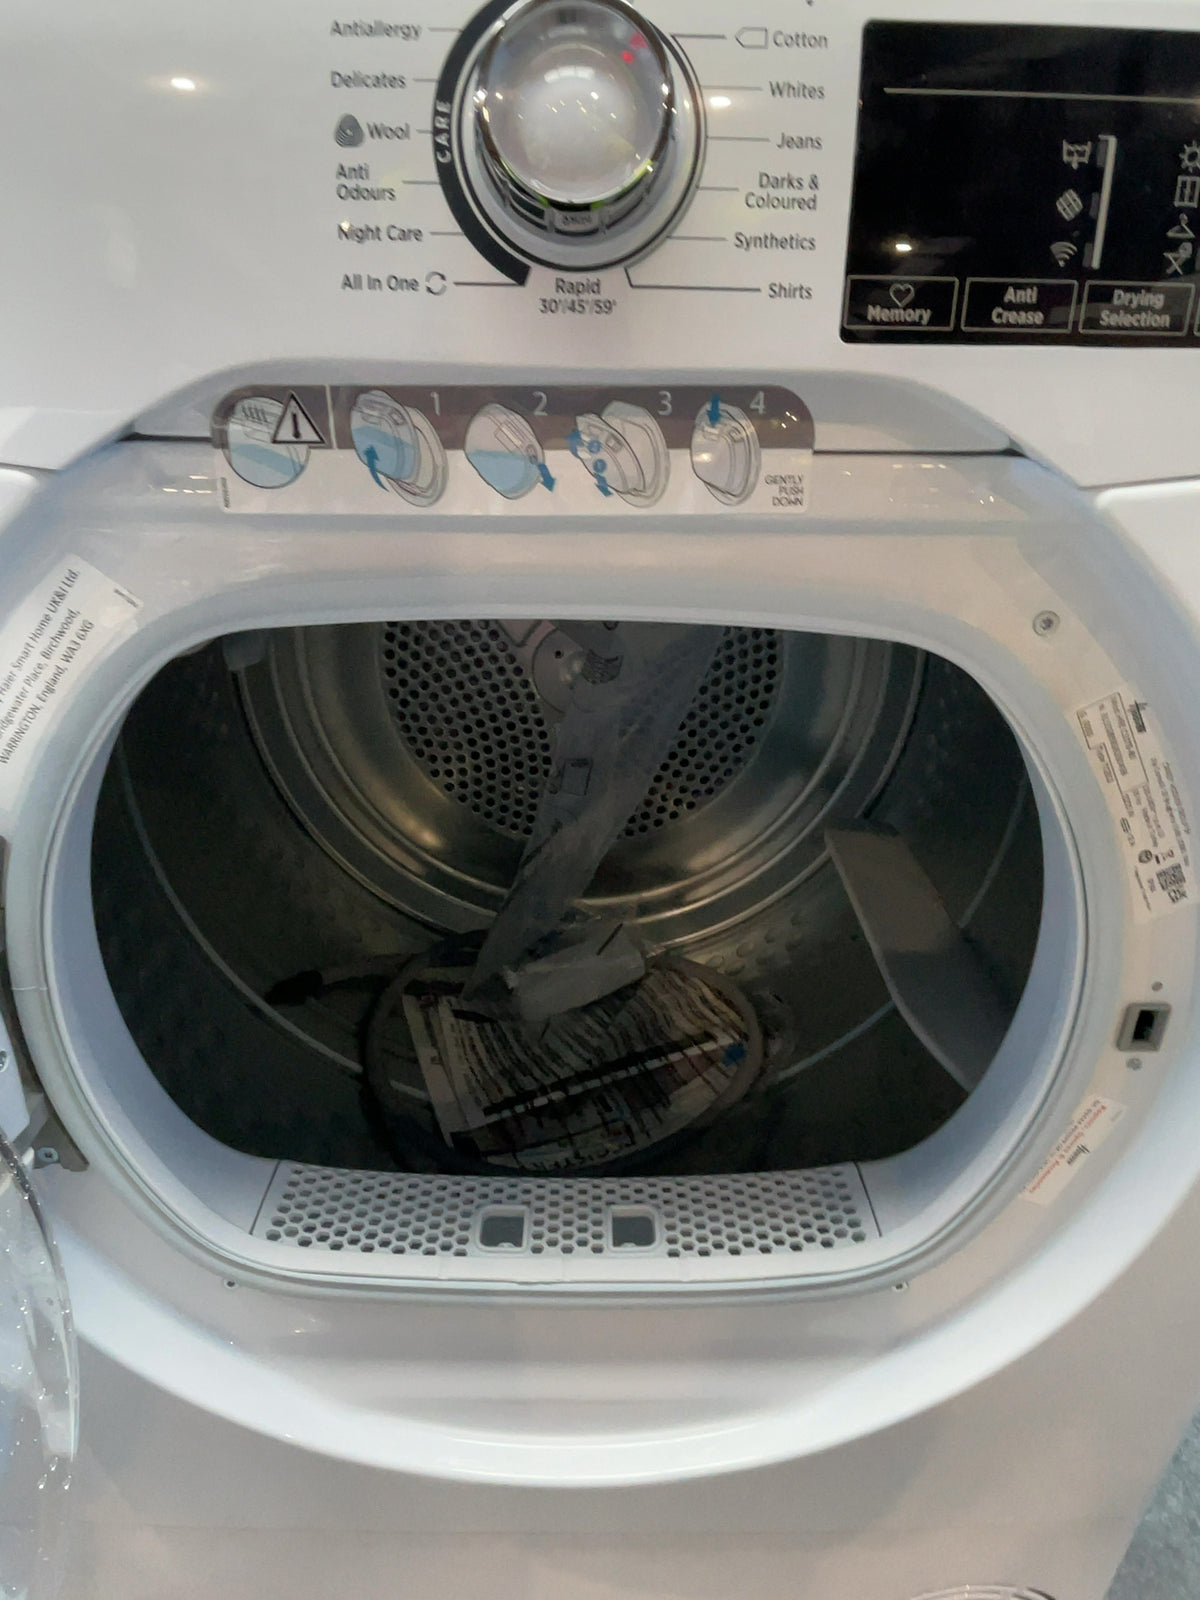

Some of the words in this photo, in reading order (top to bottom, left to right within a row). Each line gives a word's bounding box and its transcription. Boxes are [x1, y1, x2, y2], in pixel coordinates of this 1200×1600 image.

[330, 20, 421, 40] Antiallergy
[772, 30, 828, 50] Cotton
[330, 70, 406, 89] Delicates
[768, 80, 826, 101] Whites
[366, 121, 410, 141] Wool
[434, 99, 452, 164] CARE
[776, 132, 823, 151] Jeans
[336, 163, 369, 181] Anti
[758, 171, 804, 191] Darks
[807, 174, 819, 190] &
[336, 184, 396, 202] Odours
[745, 191, 818, 211] Coloured
[337, 224, 382, 244] Night
[386, 225, 423, 243] Care
[733, 231, 817, 252] Synthetics
[341, 274, 363, 291] All
[367, 274, 386, 291] In
[389, 275, 419, 292] One
[554, 278, 601, 296] Rapid
[768, 282, 813, 300] Shirts
[1003, 286, 1038, 304] Anti
[1113, 288, 1165, 309] Drying
[867, 304, 932, 325] Memory
[991, 305, 1044, 326] Crease
[1099, 308, 1170, 328] Selection
[430, 391, 440, 415] 1
[532, 391, 549, 415] 2
[657, 391, 672, 415] 3
[749, 391, 766, 414] 4
[0, 670, 17, 696] Haier
[11, 642, 36, 672] Smart
[28, 613, 53, 643] Home
[22, 661, 49, 688] Place,
[40, 607, 81, 661] Birchwood,
[36, 663, 69, 704] England,
[60, 639, 82, 664] WA3
[75, 618, 95, 642] 6XG
